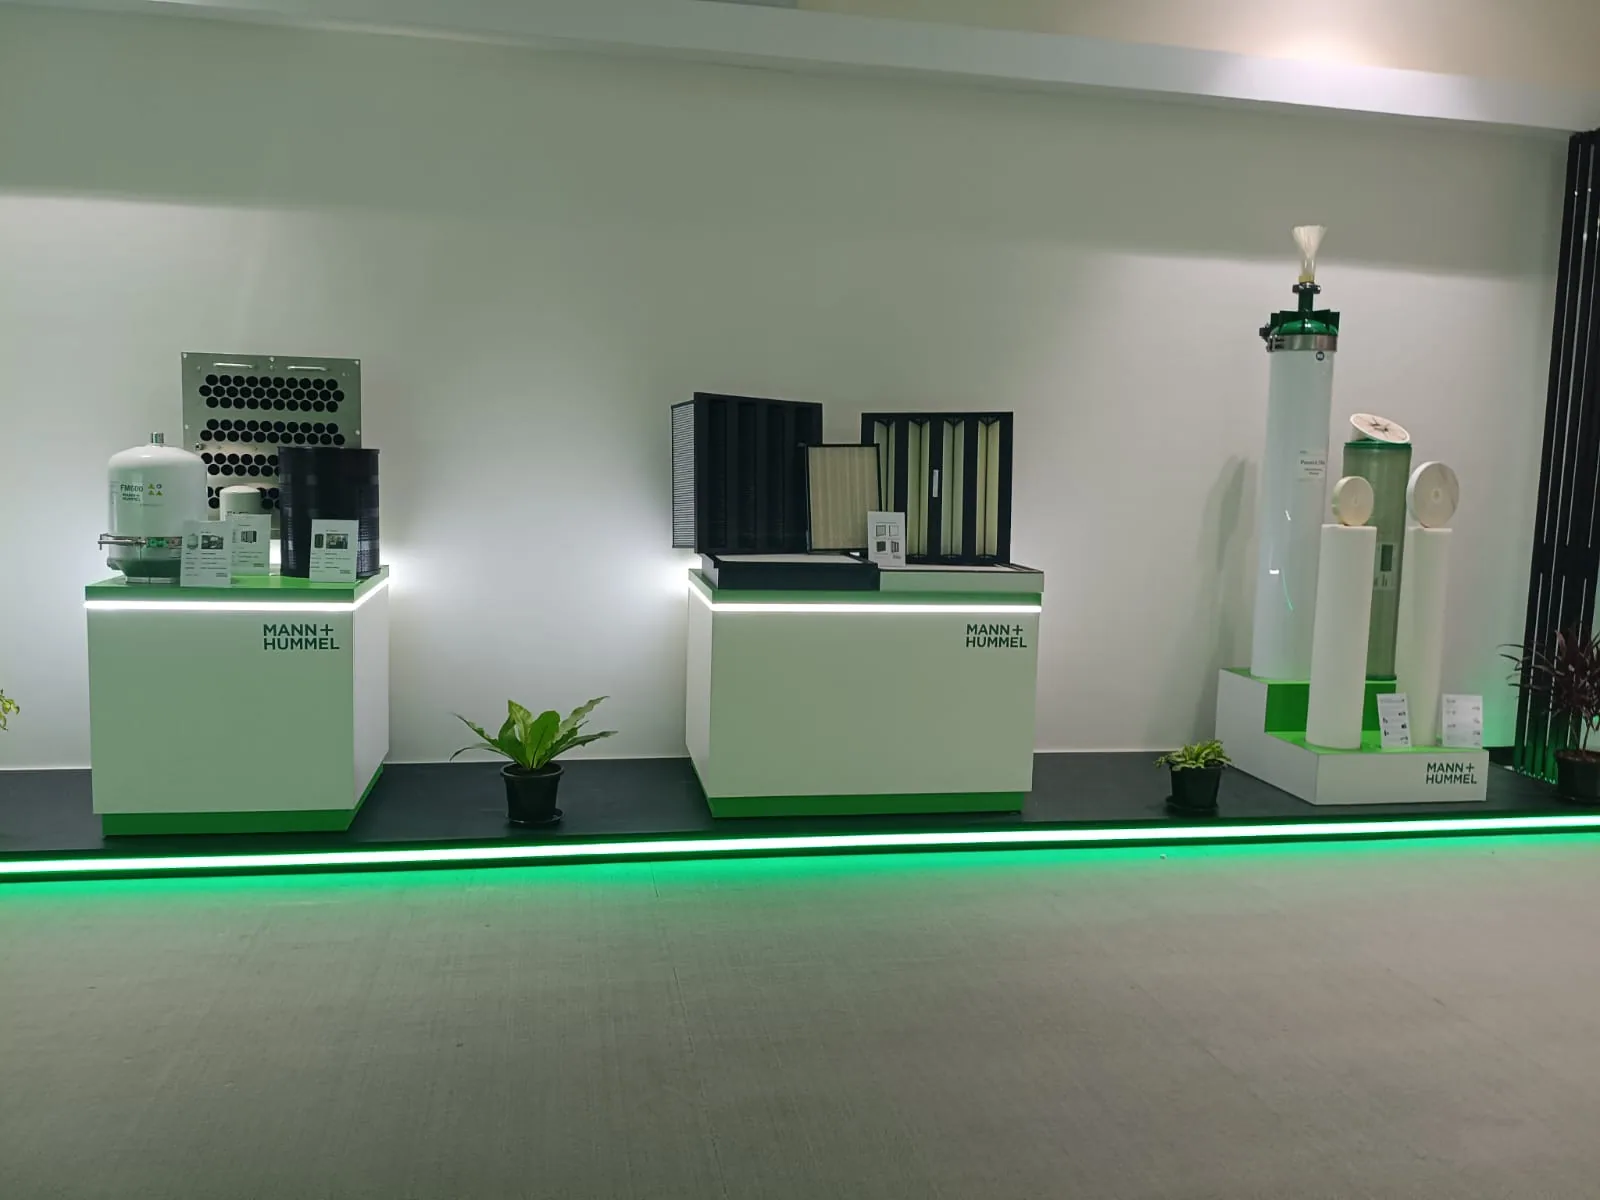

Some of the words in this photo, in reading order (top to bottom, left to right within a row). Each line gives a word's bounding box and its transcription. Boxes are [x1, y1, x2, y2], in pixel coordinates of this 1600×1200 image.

[263, 623, 334, 637] MANN+
[966, 623, 1024, 635] MANN+
[263, 637, 340, 650] HUMMEL
[965, 636, 1028, 648] HUMMEL
[1427, 762, 1475, 773] MANN+
[1425, 773, 1477, 785] HUMMEL
